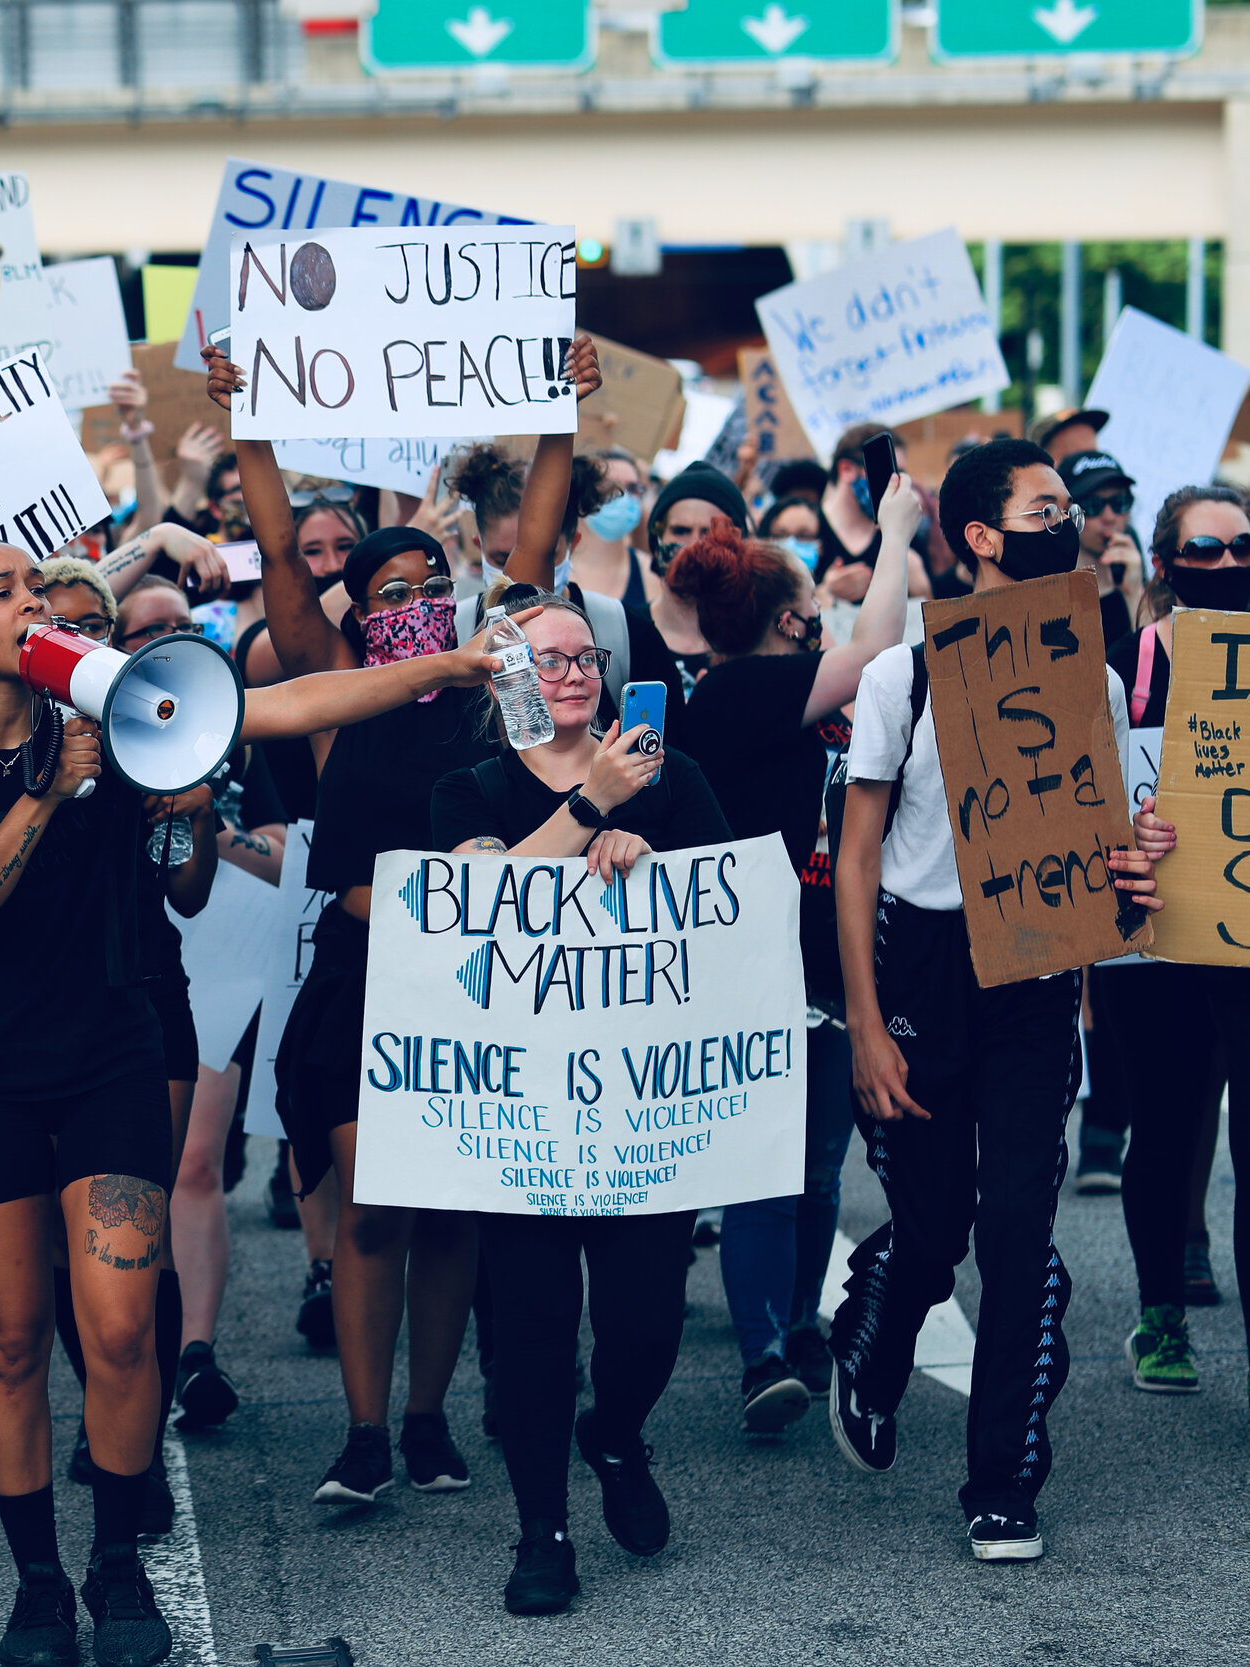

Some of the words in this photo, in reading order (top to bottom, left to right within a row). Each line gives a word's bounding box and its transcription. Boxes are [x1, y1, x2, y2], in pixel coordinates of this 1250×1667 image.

[2, 263, 43, 283] BLM
[238, 241, 337, 312] NO
[375, 240, 577, 306] JUSTICE
[251, 335, 356, 417] NO
[420, 857, 597, 937] BLACK
[615, 851, 741, 935] LIVES
[481, 938, 691, 1015] MATTER!
[367, 1031, 527, 1099] SILENCE
[567, 1049, 603, 1106] IS
[621, 1028, 792, 1101] VIOLENCE!
[421, 1096, 551, 1133] SILENCE
[575, 1106, 602, 1135] IS
[625, 1091, 748, 1133] VIOLENCE!
[456, 1132, 559, 1163] SILENCE
[578, 1143, 599, 1165] IS
[614, 1129, 712, 1165] VIOLENCE!
[500, 1166, 576, 1189] SILENCE
[586, 1169, 601, 1189] IS
[605, 1163, 678, 1189] VIOLENCE!
[526, 1192, 567, 1207] SILENCE
[574, 1193, 586, 1207] IS
[590, 1190, 649, 1208] VIOLENCE!
[539, 1207, 568, 1217] SILENCE
[579, 1206, 625, 1217] VIOLENCE!
